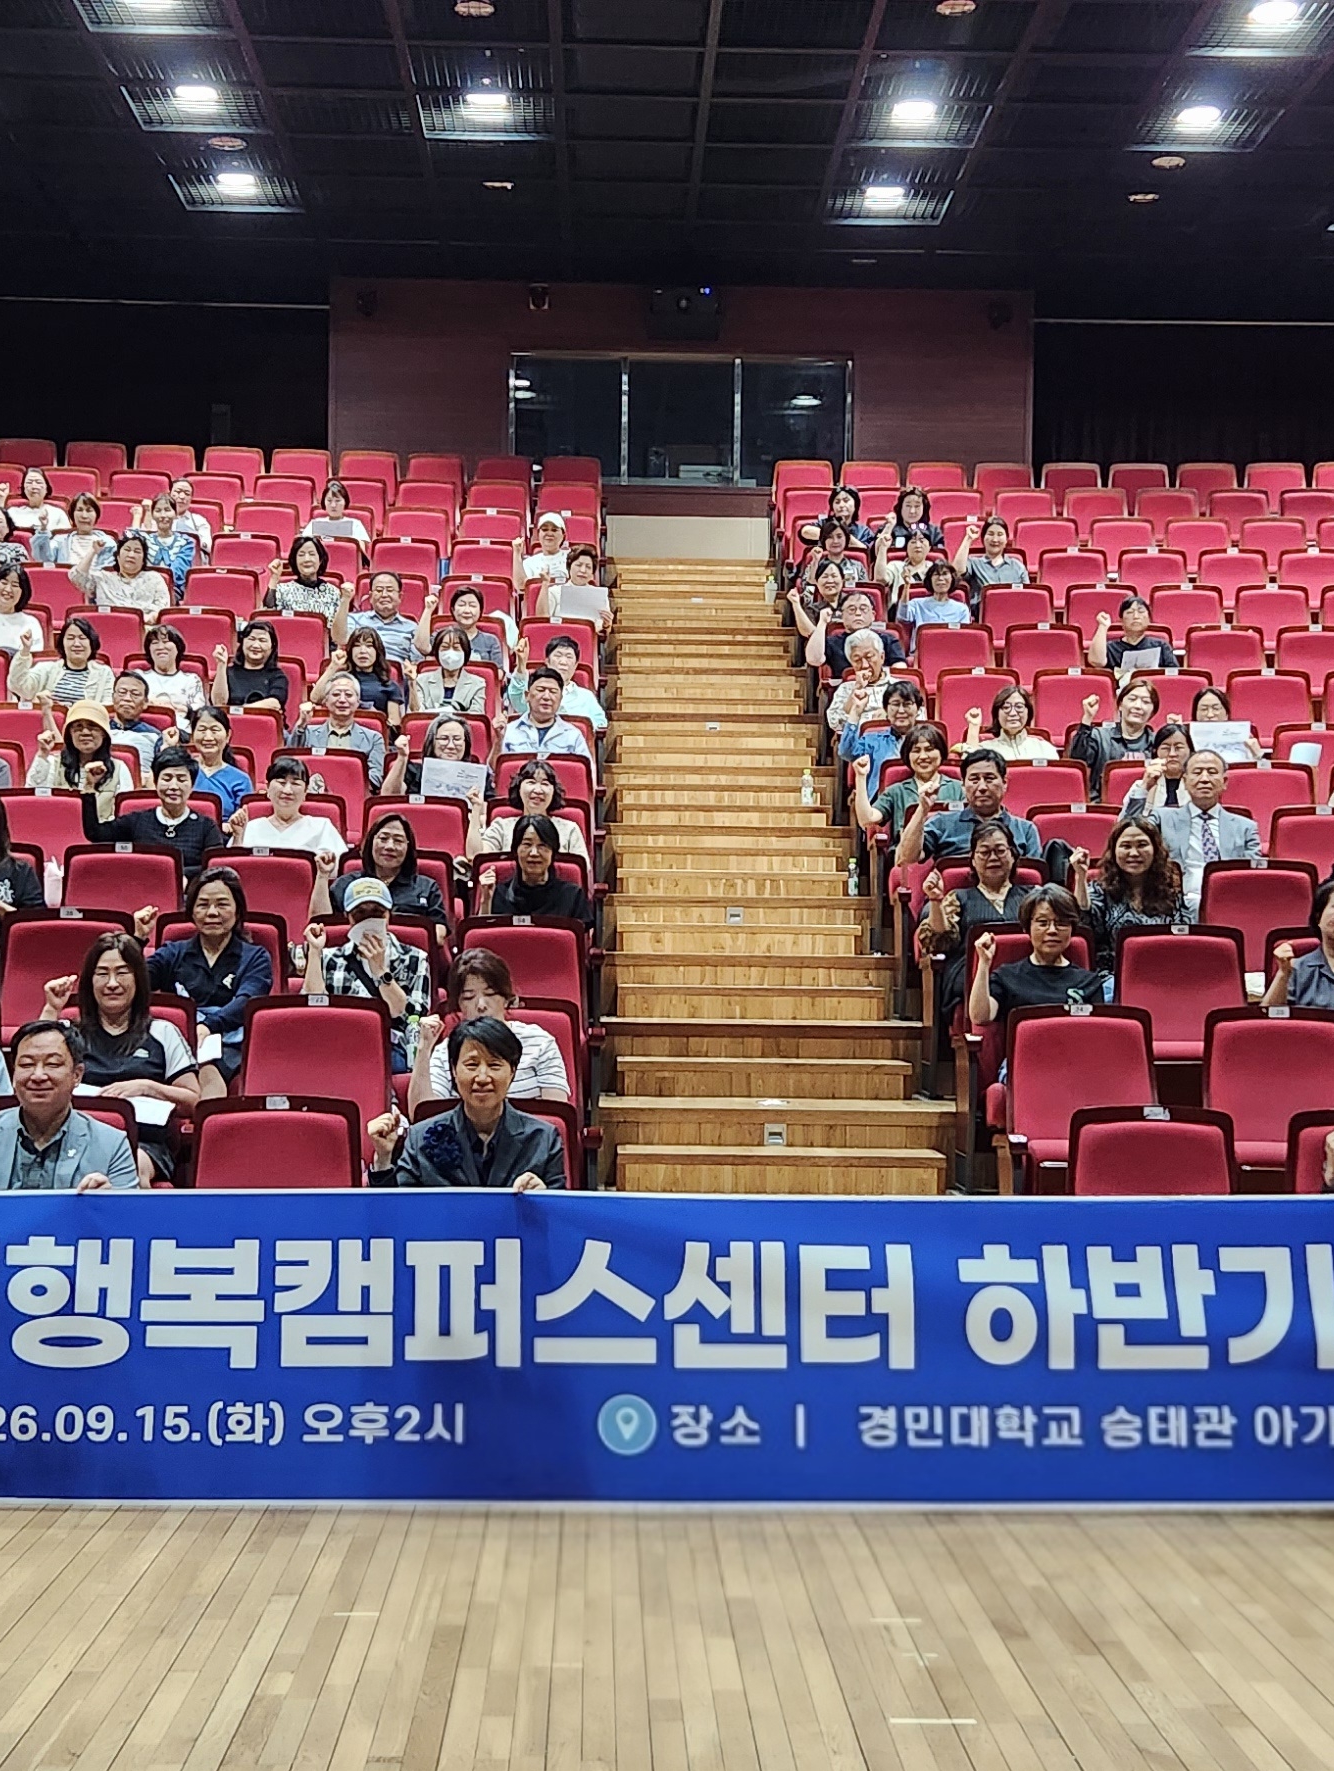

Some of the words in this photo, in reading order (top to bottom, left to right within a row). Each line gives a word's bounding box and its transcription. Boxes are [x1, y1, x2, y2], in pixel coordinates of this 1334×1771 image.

[302, 1401, 464, 1445] 오후2시
[671, 1405, 761, 1447] 장소
[859, 1405, 1083, 1448] 경민대학교
[1101, 1405, 1238, 1448] 승태관
